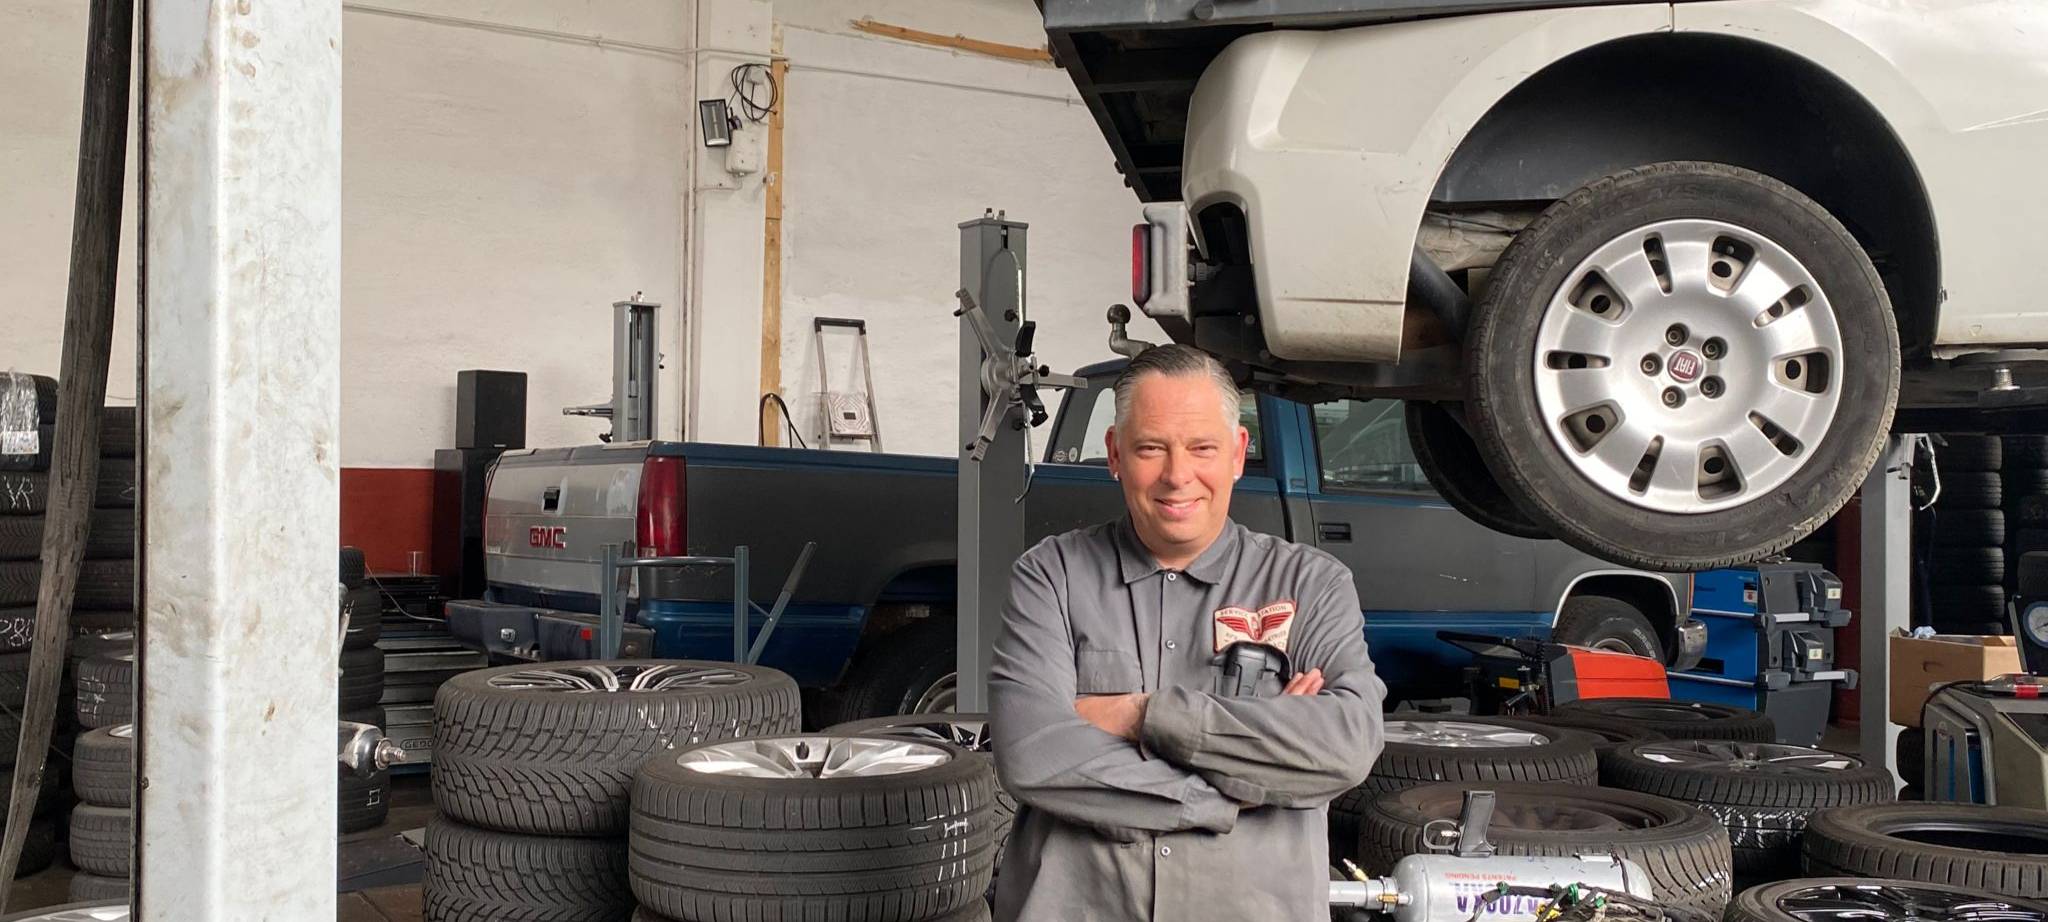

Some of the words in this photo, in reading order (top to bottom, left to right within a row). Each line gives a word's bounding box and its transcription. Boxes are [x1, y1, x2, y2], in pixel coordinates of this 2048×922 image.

[1674, 357, 1696, 375] FIAT
[529, 526, 566, 549] GMC
[1220, 609, 1249, 618] SERVICE
[404, 740, 432, 749] GEDO
[1444, 872, 1480, 880] PENDING
[1481, 873, 1517, 881] PATENTS
